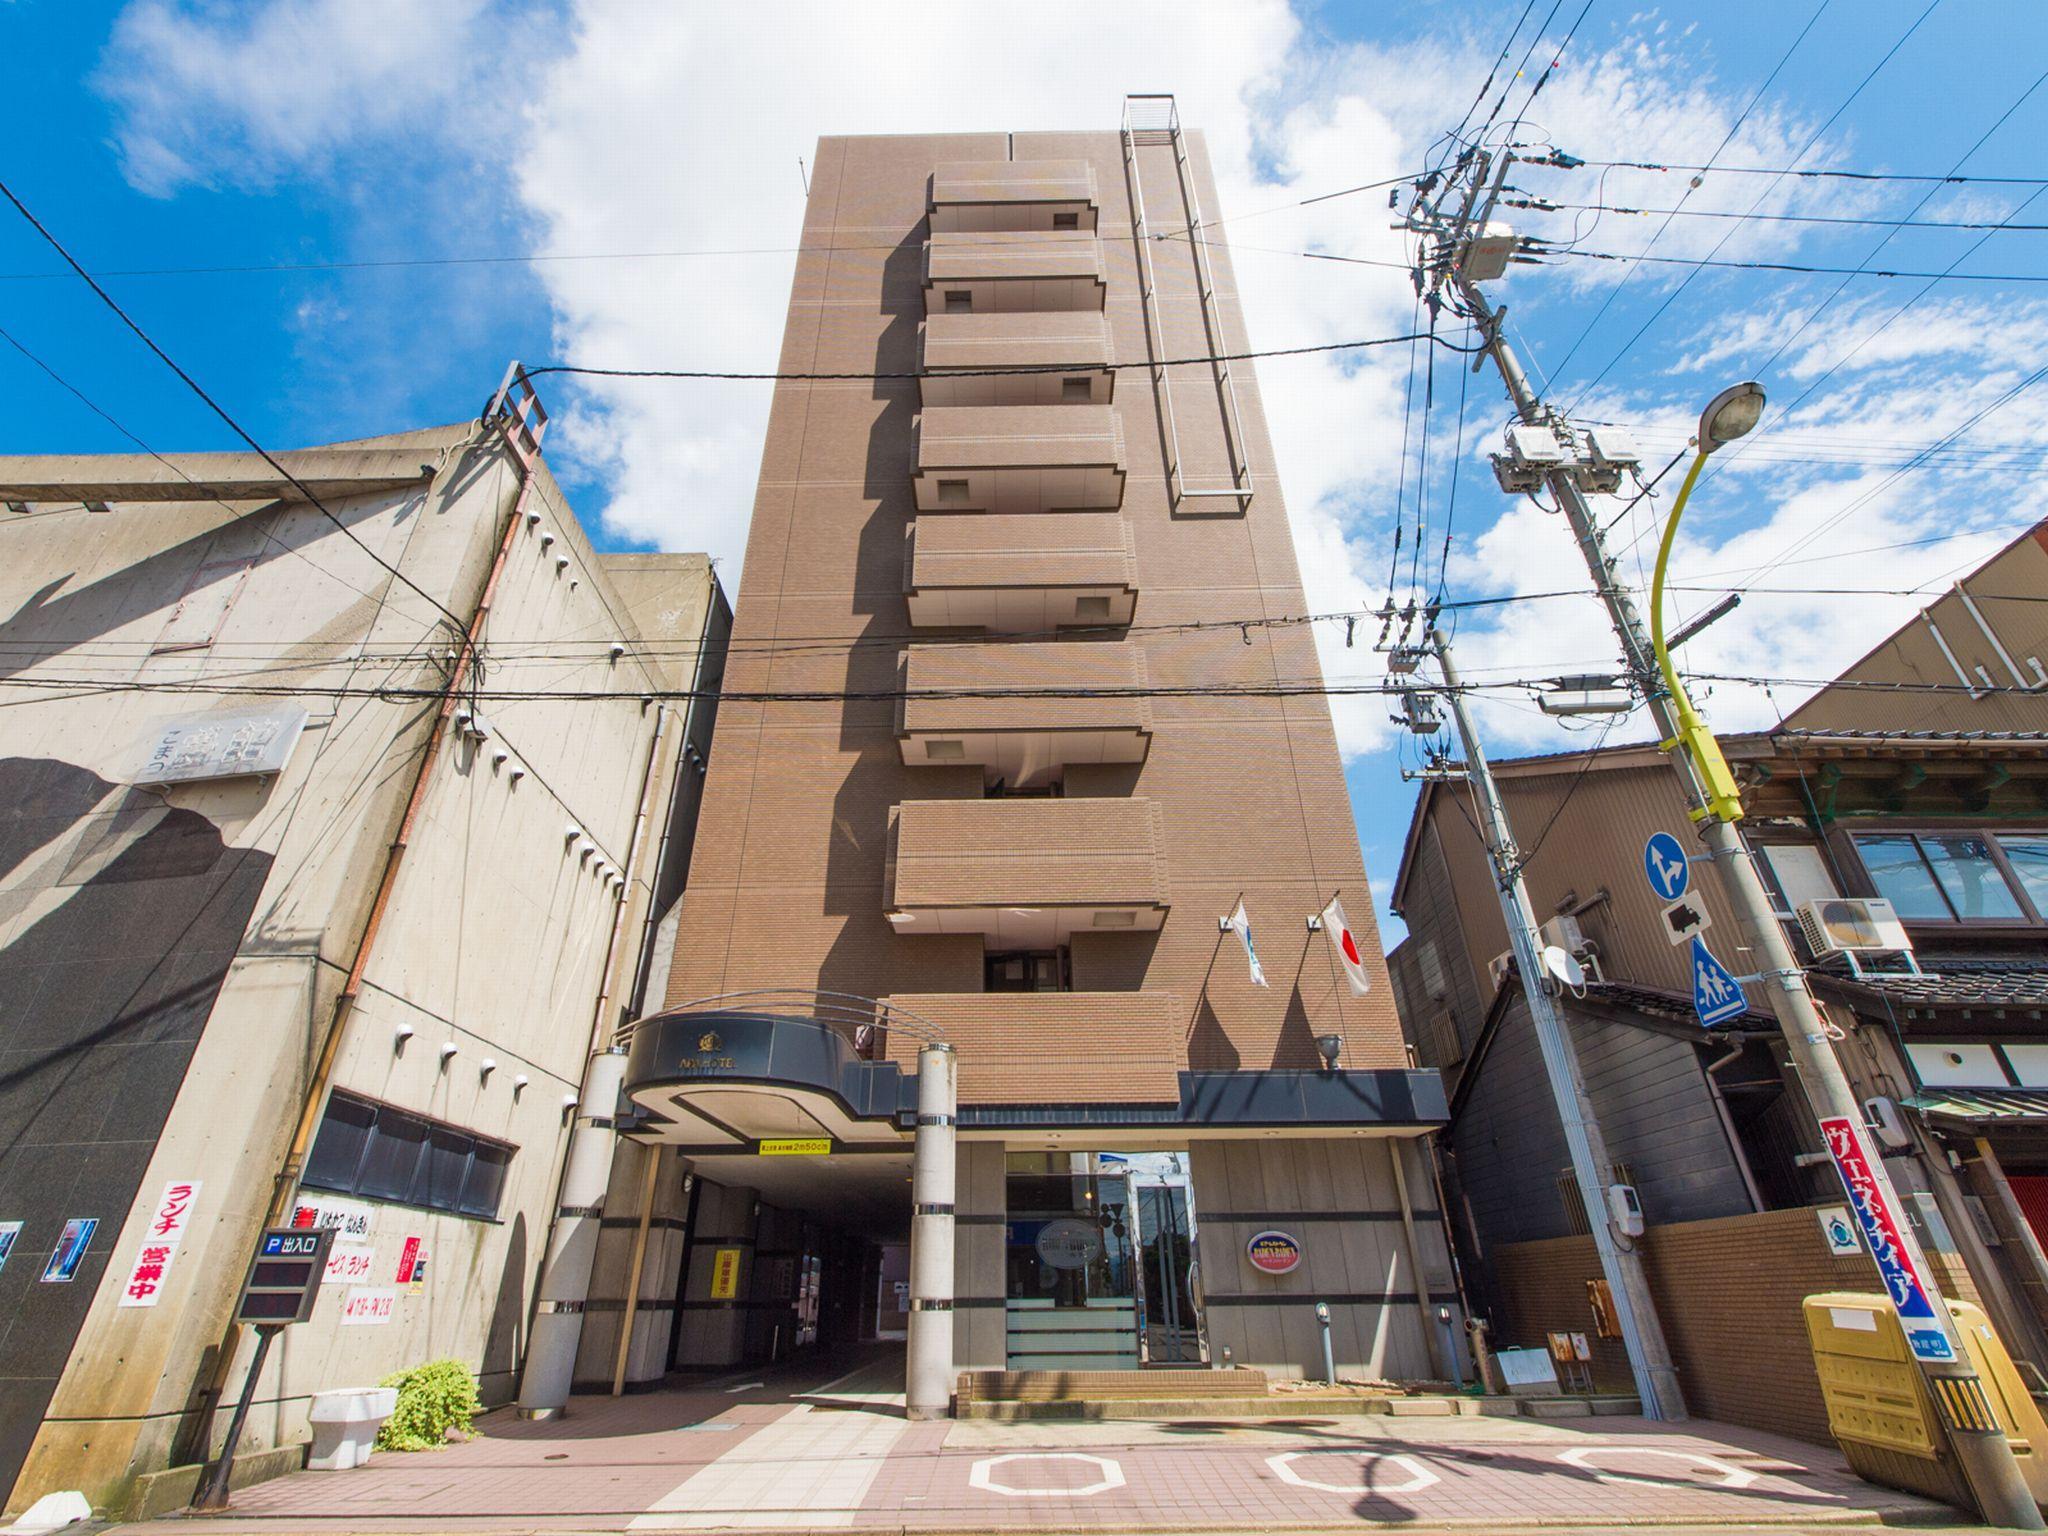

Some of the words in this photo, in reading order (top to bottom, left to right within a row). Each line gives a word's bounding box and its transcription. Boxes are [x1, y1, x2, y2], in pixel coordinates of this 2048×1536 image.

[154, 1185, 192, 1236] ランチ
[266, 1238, 281, 1252] P
[281, 1237, 317, 1253] 出入口
[128, 1246, 171, 1300] 営業中
